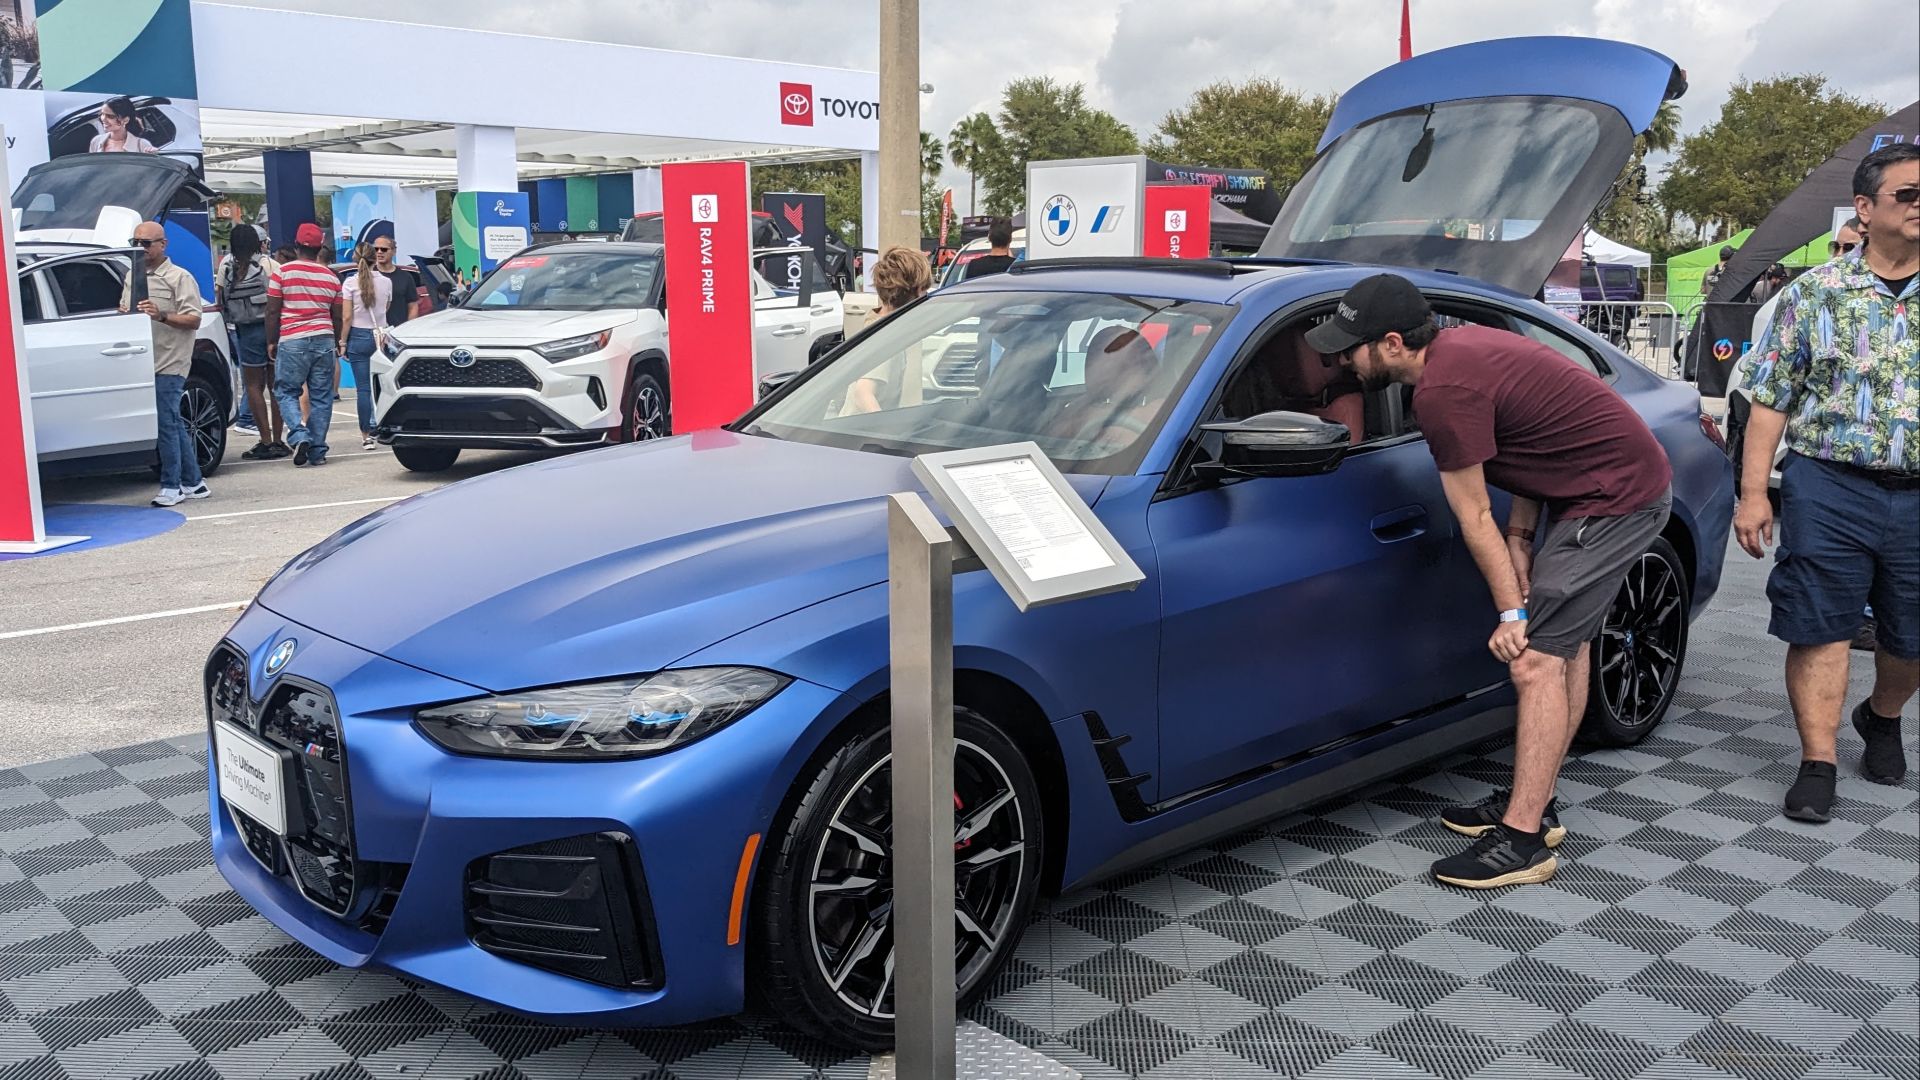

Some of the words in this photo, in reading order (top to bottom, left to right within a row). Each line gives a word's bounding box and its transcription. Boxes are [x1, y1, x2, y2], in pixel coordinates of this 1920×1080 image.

[700, 227, 713, 266] RAV4
[701, 269, 715, 313] PRIME
[224, 763, 243, 791] Driving
[226, 747, 238, 766] The
[238, 754, 265, 783] Ultimate
